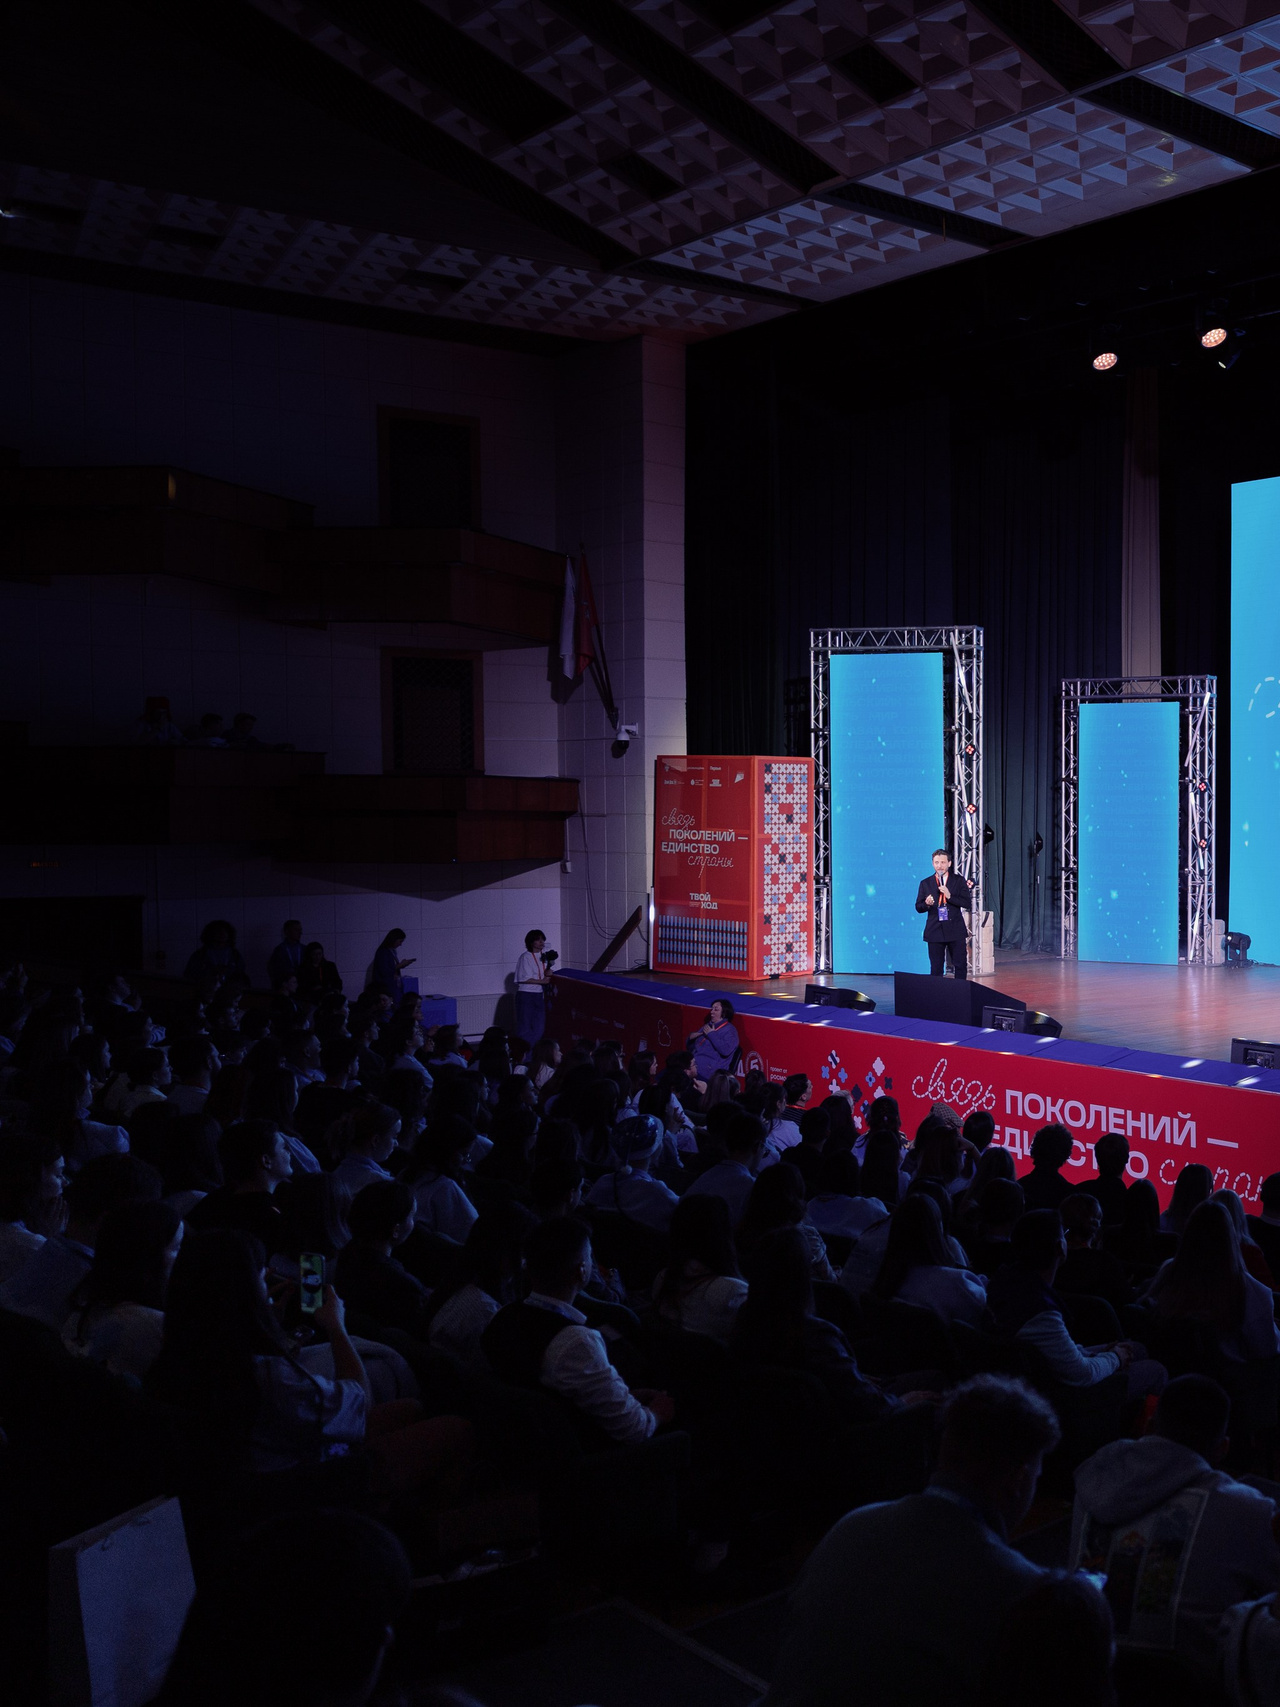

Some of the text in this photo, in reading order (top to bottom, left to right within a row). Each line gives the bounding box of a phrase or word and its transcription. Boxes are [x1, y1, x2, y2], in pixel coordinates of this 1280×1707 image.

[669, 829, 735, 842] ПОКОЛЕНИЙ
[661, 842, 719, 854] ЕДИНСТВО
[690, 892, 711, 901] ТВОЙ
[1005, 1089, 1196, 1148] ПОКОЛЕНИЙ
